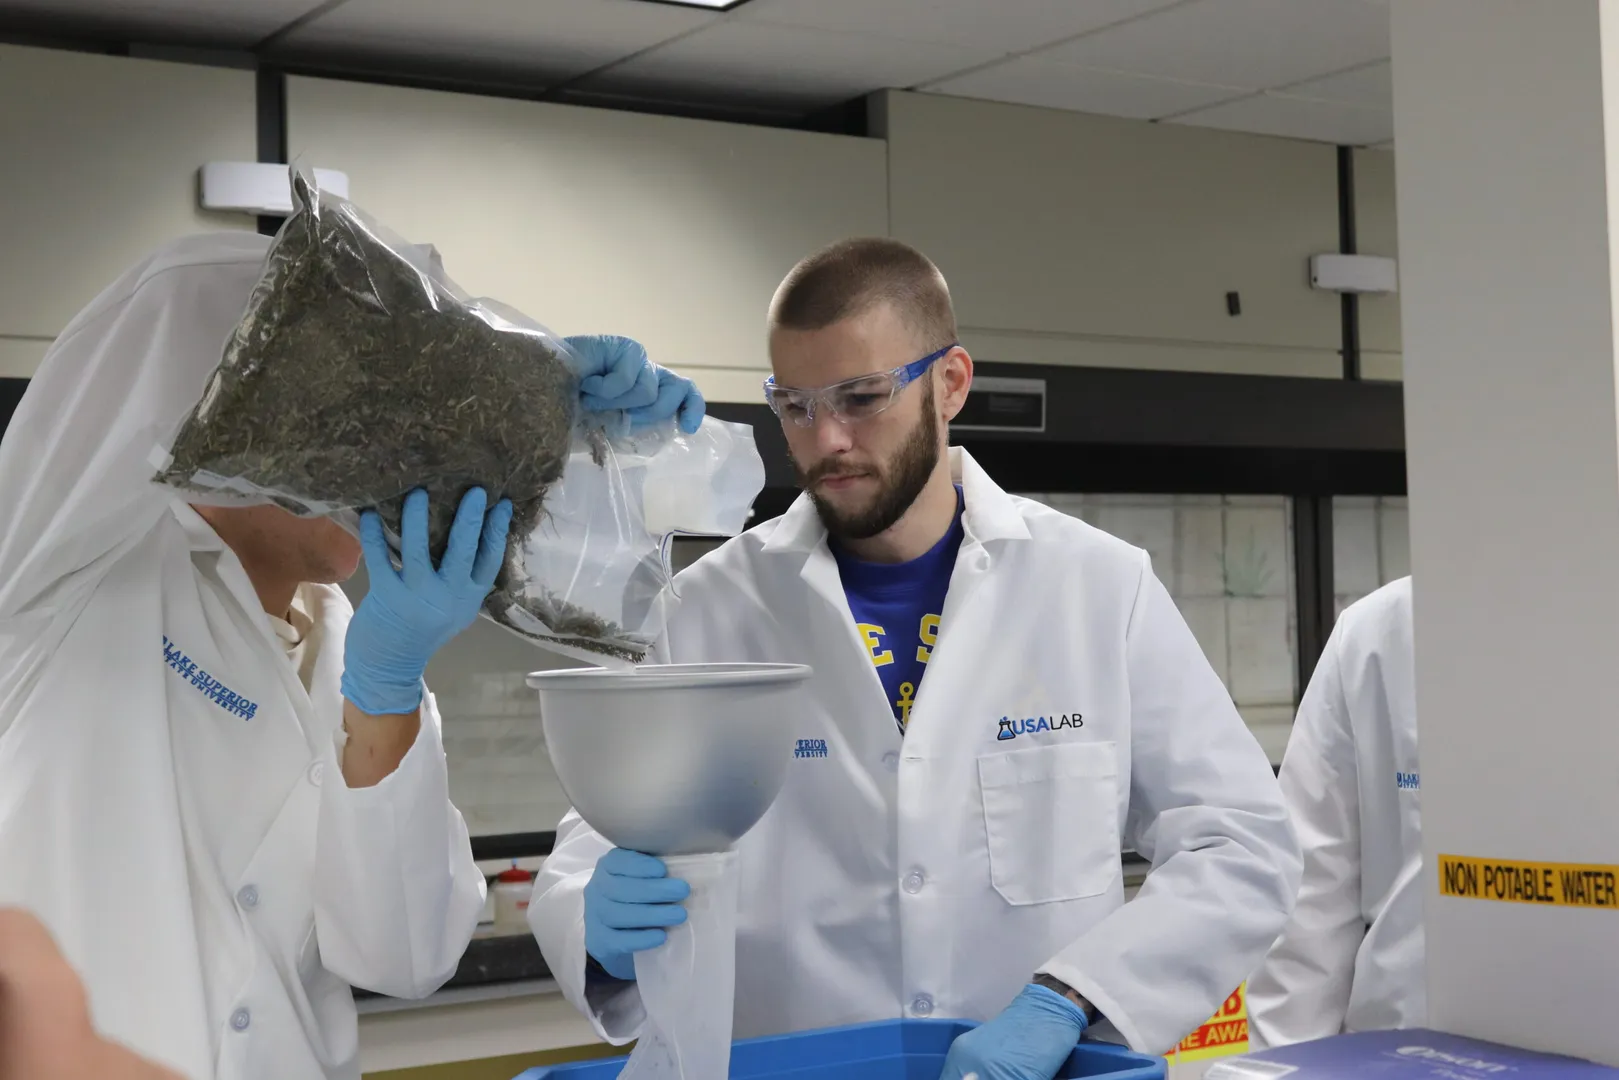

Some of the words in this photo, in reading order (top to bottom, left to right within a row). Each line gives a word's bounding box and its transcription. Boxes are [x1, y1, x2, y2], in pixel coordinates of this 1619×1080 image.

[164, 642, 198, 673] LAKE
[197, 670, 258, 714] SUPERIOR
[164, 652, 189, 679] TATE
[190, 678, 254, 721] UNIVERSITY
[792, 750, 828, 759] VERSITY
[796, 739, 828, 749] ERIOR
[1444, 861, 1478, 896] NON
[1484, 865, 1554, 902] POTABLE
[1560, 869, 1617, 906] WATER
